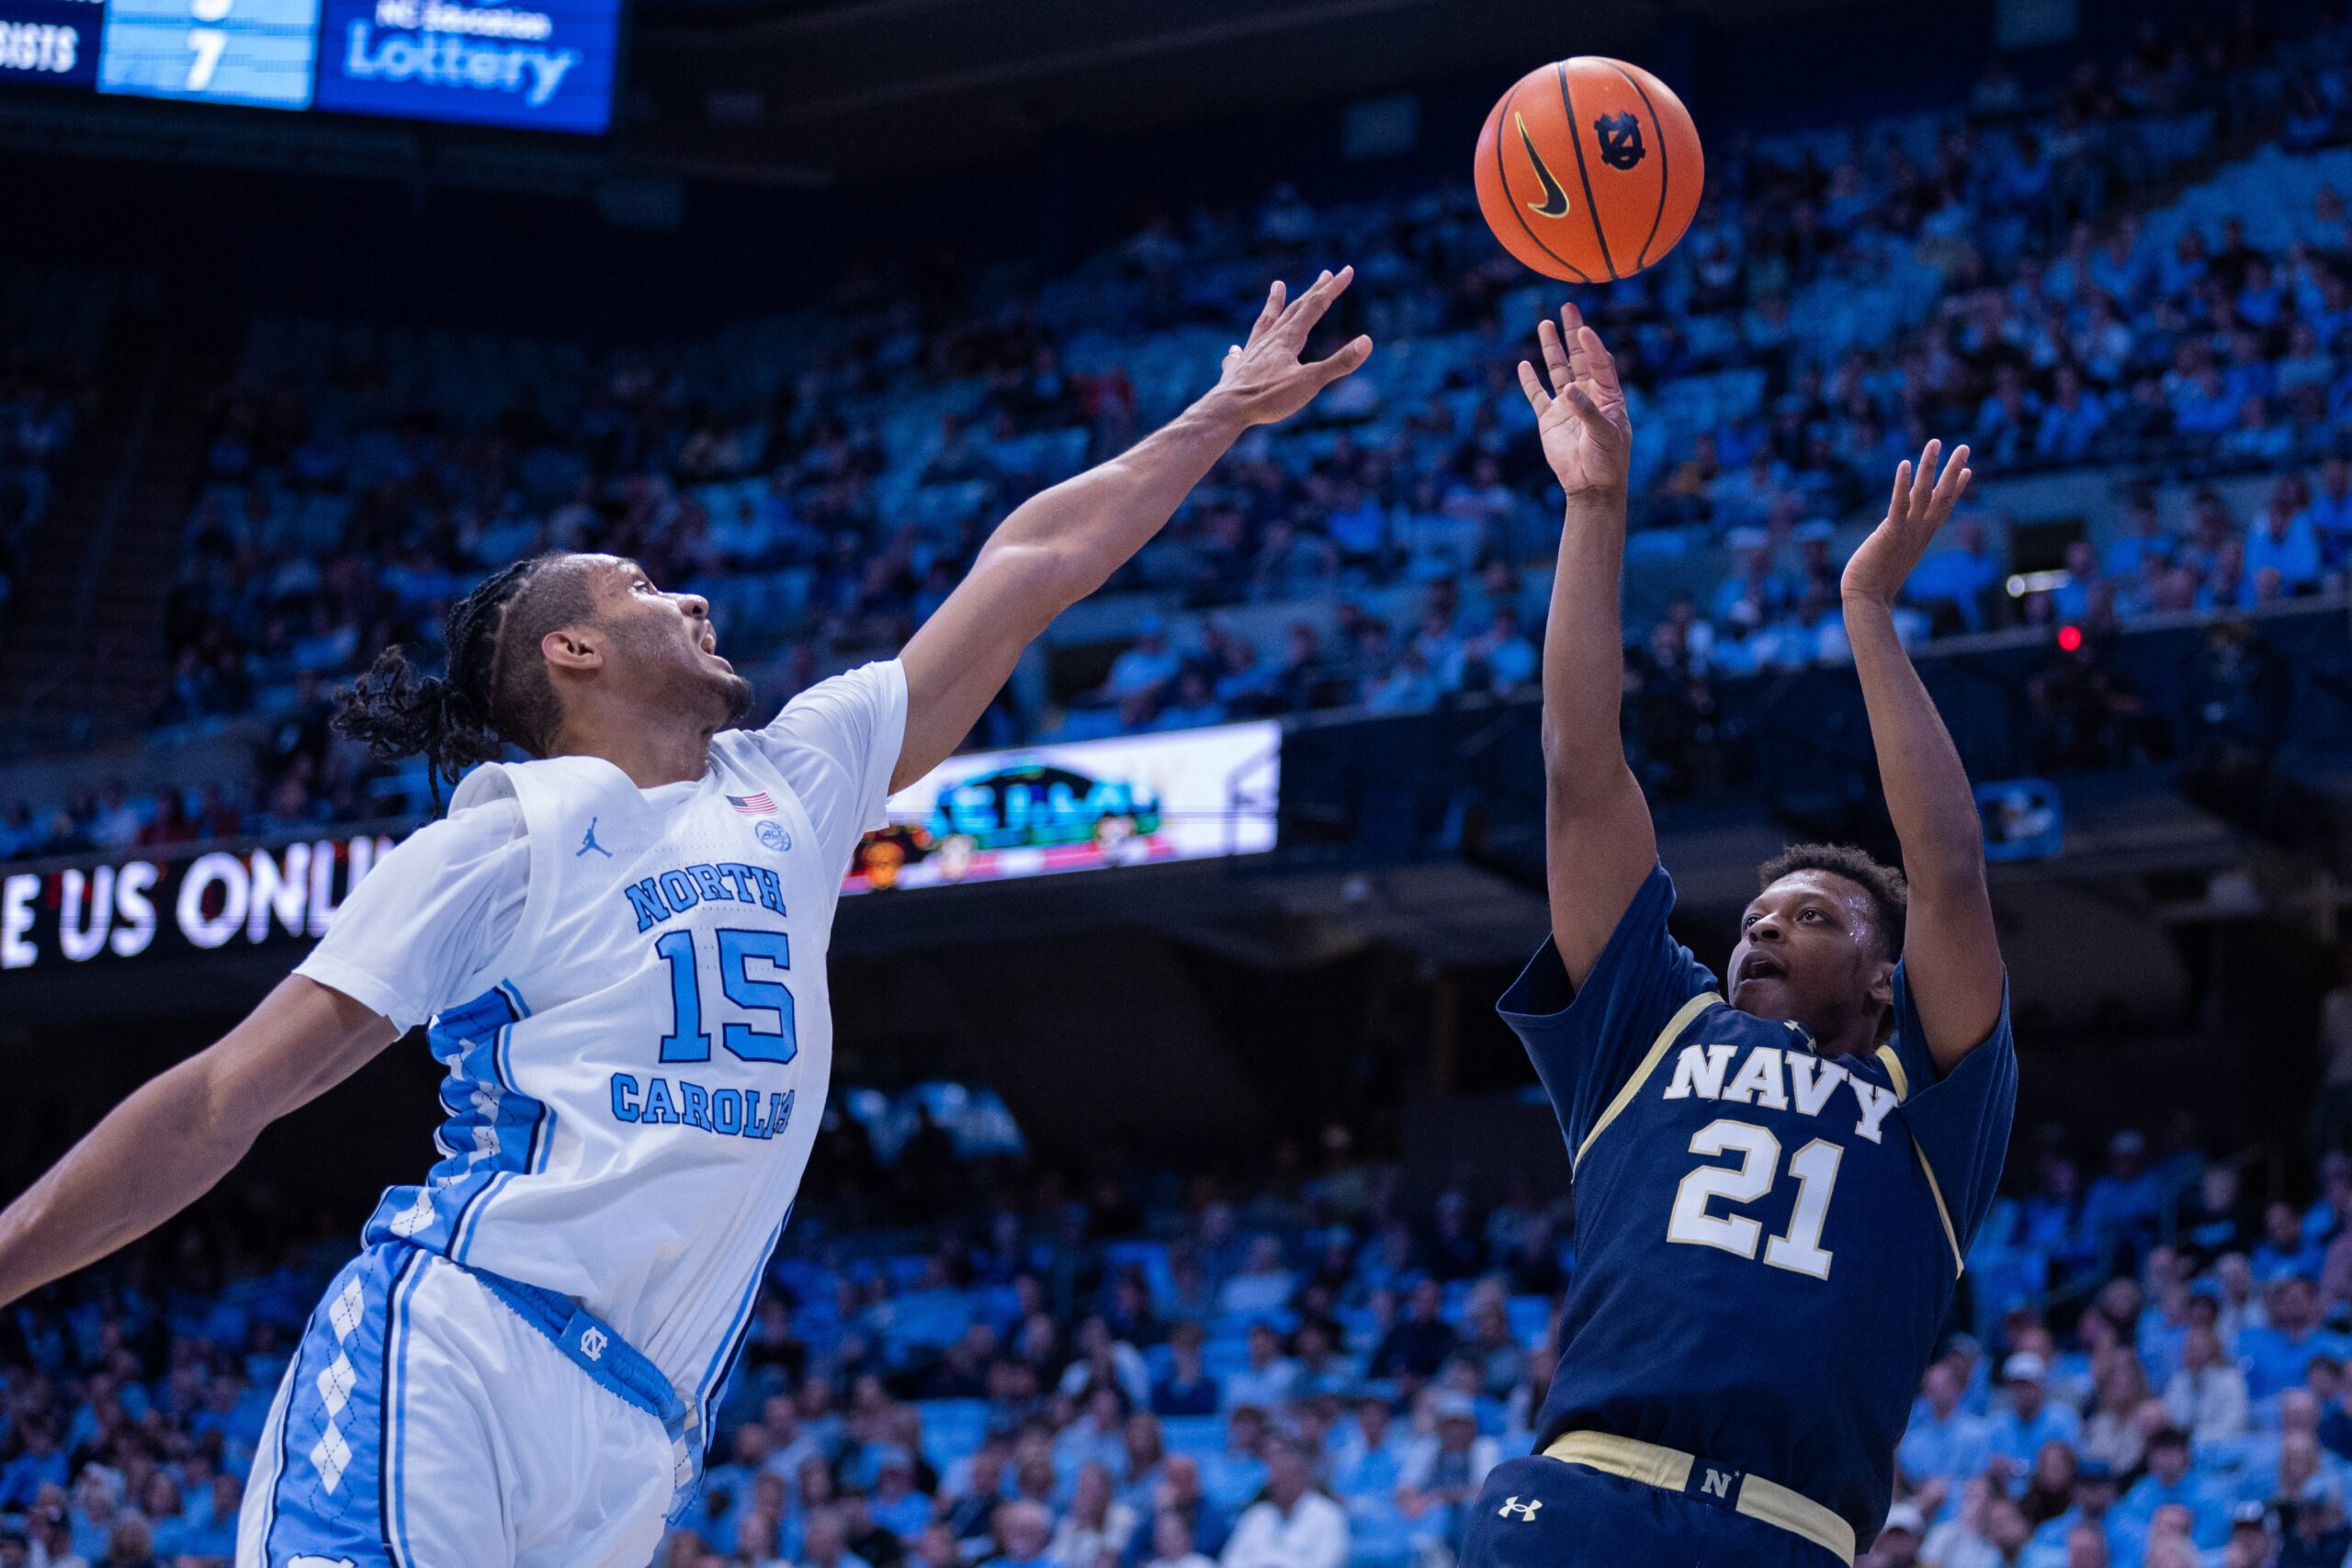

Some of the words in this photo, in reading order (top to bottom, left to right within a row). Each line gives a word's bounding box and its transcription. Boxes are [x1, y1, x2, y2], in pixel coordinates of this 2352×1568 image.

[187, 29, 227, 91] 7
[349, 19, 579, 106] Lottery
[59, 860, 159, 963] US
[176, 833, 396, 948] ONLI
[625, 863, 787, 933] NORTH
[655, 928, 798, 1064] 15
[1663, 1043, 1900, 1145] NAVY
[1666, 1119, 1845, 1281] 21
